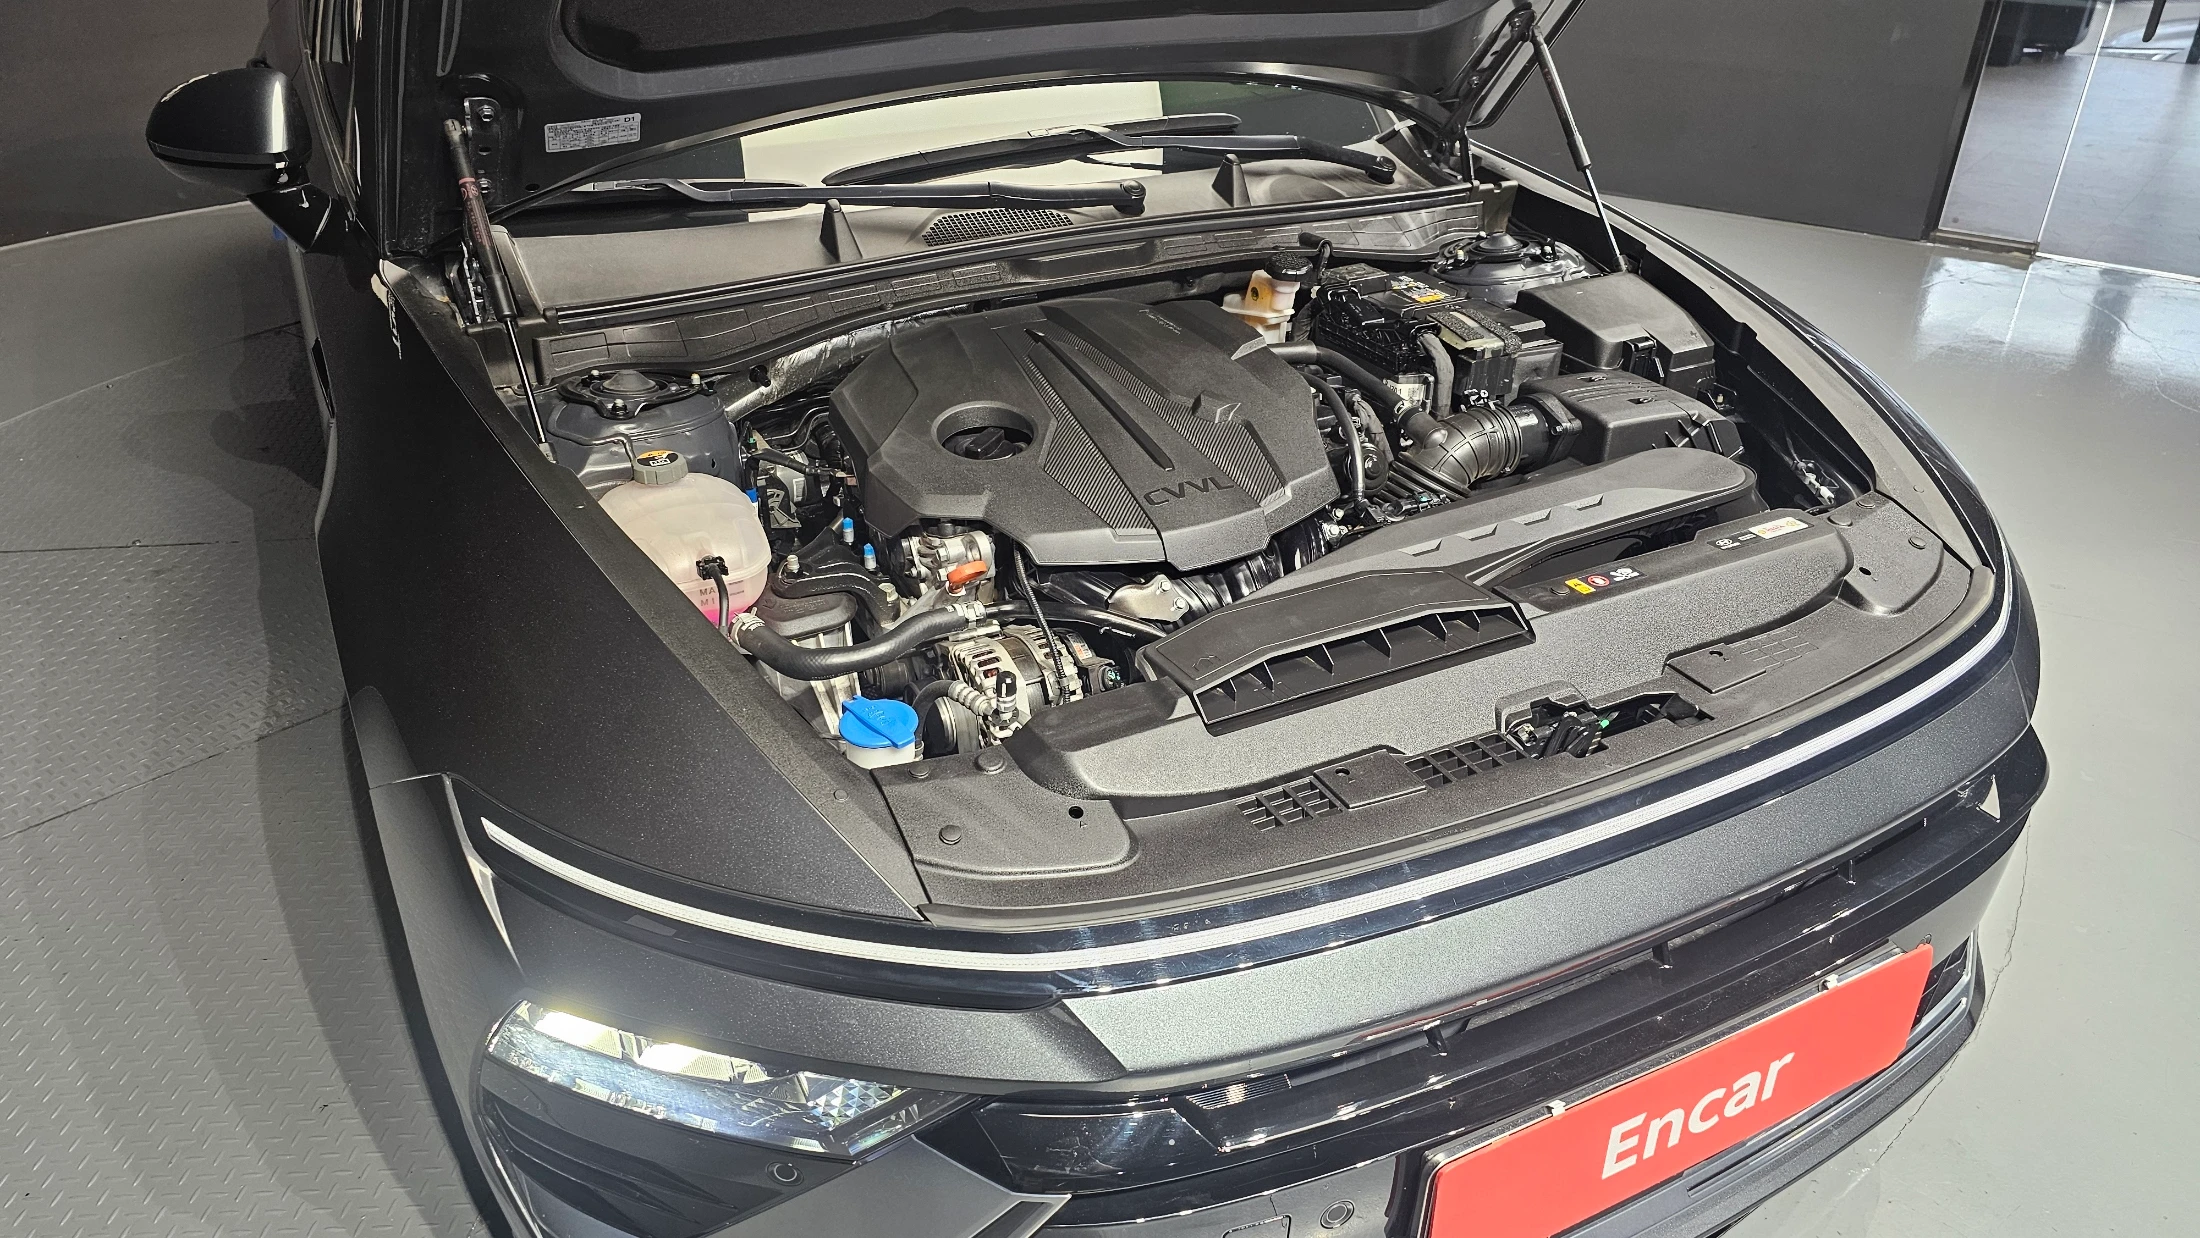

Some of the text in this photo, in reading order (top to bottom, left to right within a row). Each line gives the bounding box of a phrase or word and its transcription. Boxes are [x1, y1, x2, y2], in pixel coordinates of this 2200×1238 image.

[1144, 477, 1234, 506] CVVL
[700, 587, 716, 596] MA
[701, 598, 715, 607] MI
[1602, 1052, 1795, 1181] Encar
